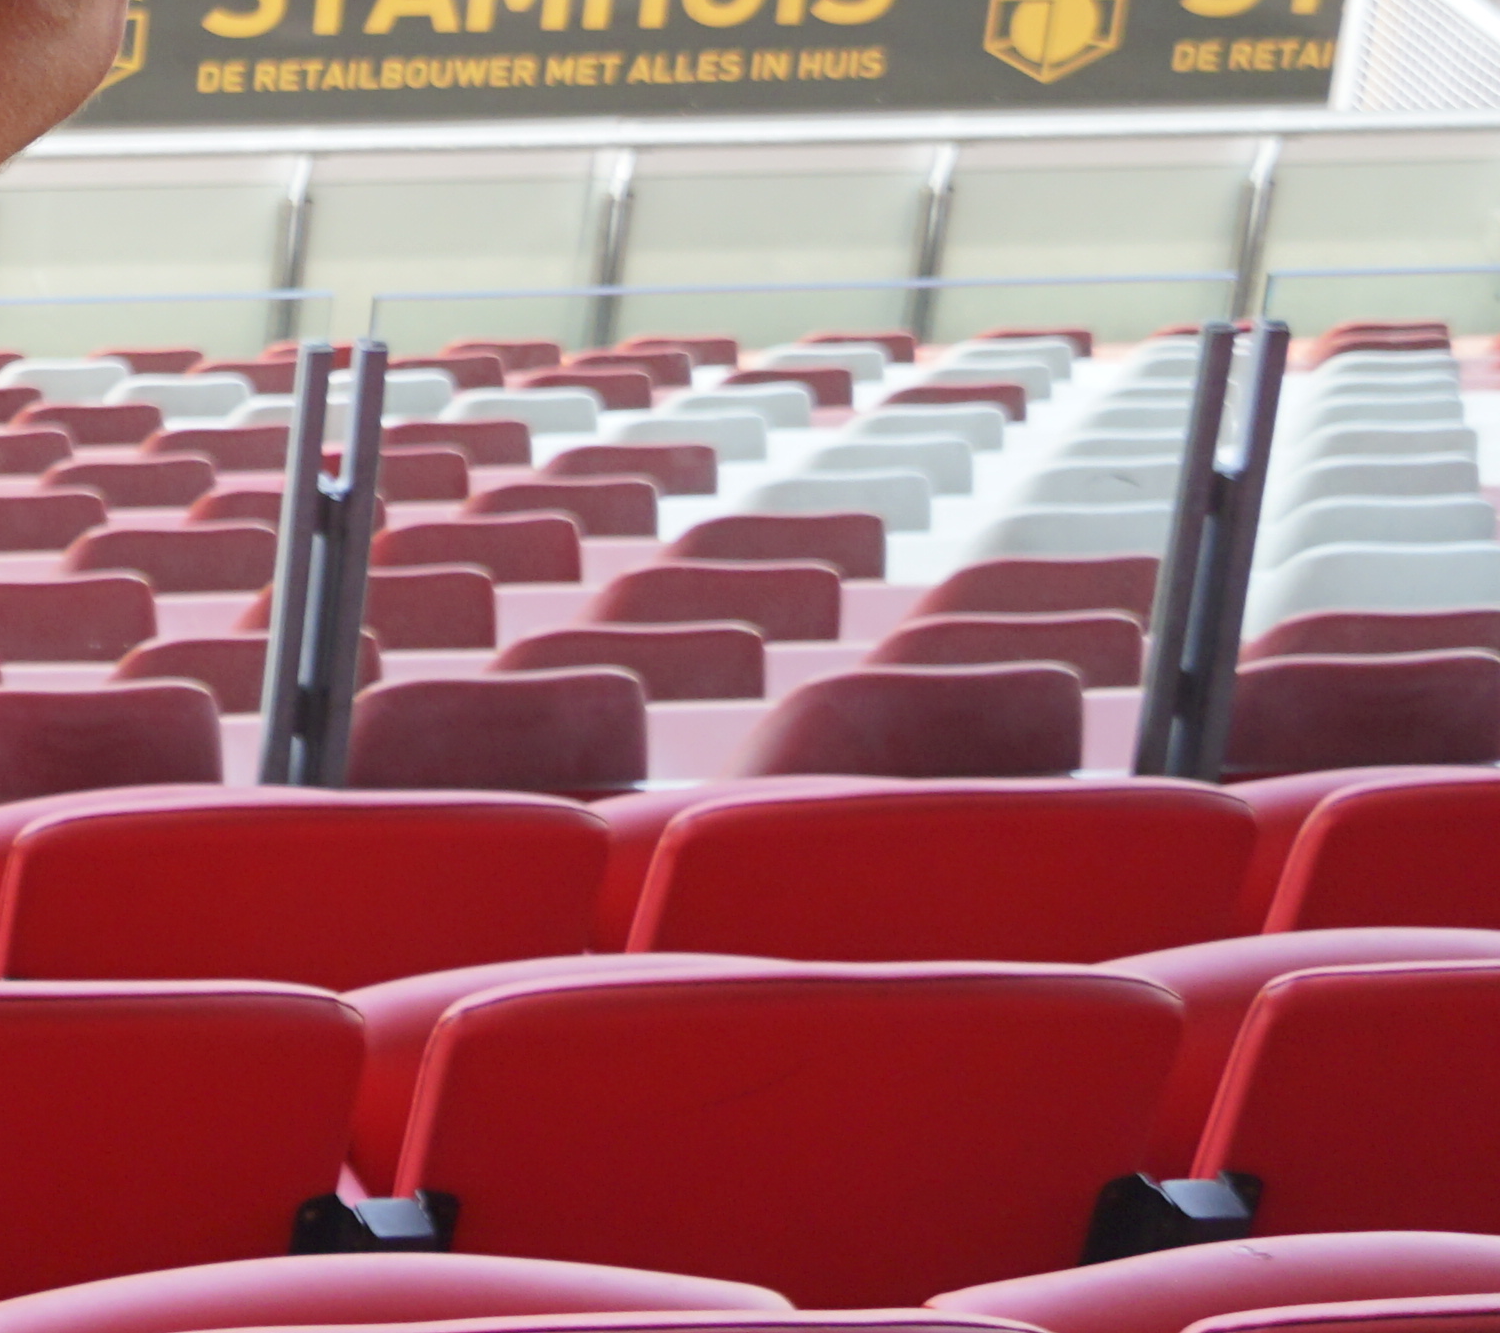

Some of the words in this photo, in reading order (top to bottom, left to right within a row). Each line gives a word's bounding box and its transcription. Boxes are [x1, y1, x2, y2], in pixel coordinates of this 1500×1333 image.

[197, 58, 245, 94] DE
[253, 55, 536, 93] RETAILBOUWER
[544, 51, 623, 88] MET
[626, 49, 742, 85] ALLES
[751, 48, 790, 82] IN
[797, 46, 887, 80] HUIS
[1171, 39, 1220, 73] DE
[1228, 36, 1338, 71] RETAI
